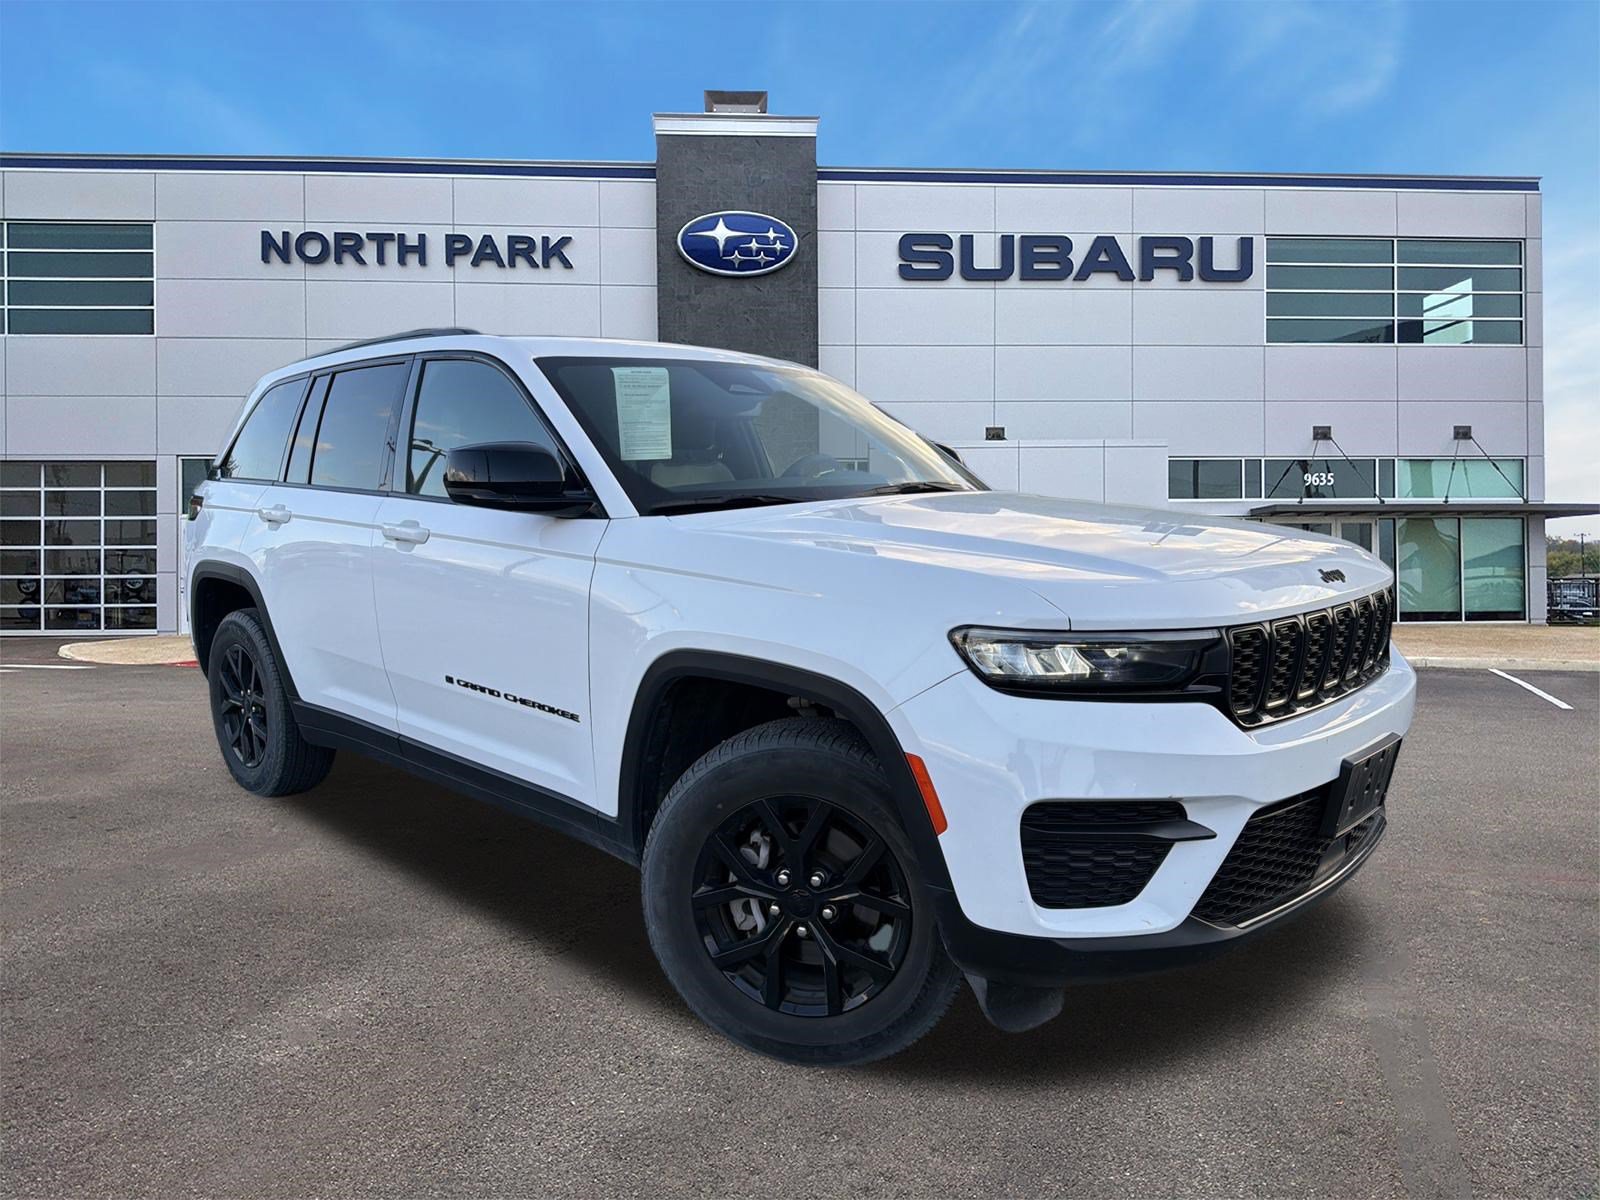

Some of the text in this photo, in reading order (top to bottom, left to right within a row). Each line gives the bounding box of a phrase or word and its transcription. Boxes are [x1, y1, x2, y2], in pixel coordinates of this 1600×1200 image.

[260, 230, 574, 269] NORTH PARK
[898, 232, 1254, 282] SUBARU
[1303, 472, 1335, 486] 9635
[456, 678, 581, 723] GRAND CHEROKEE
